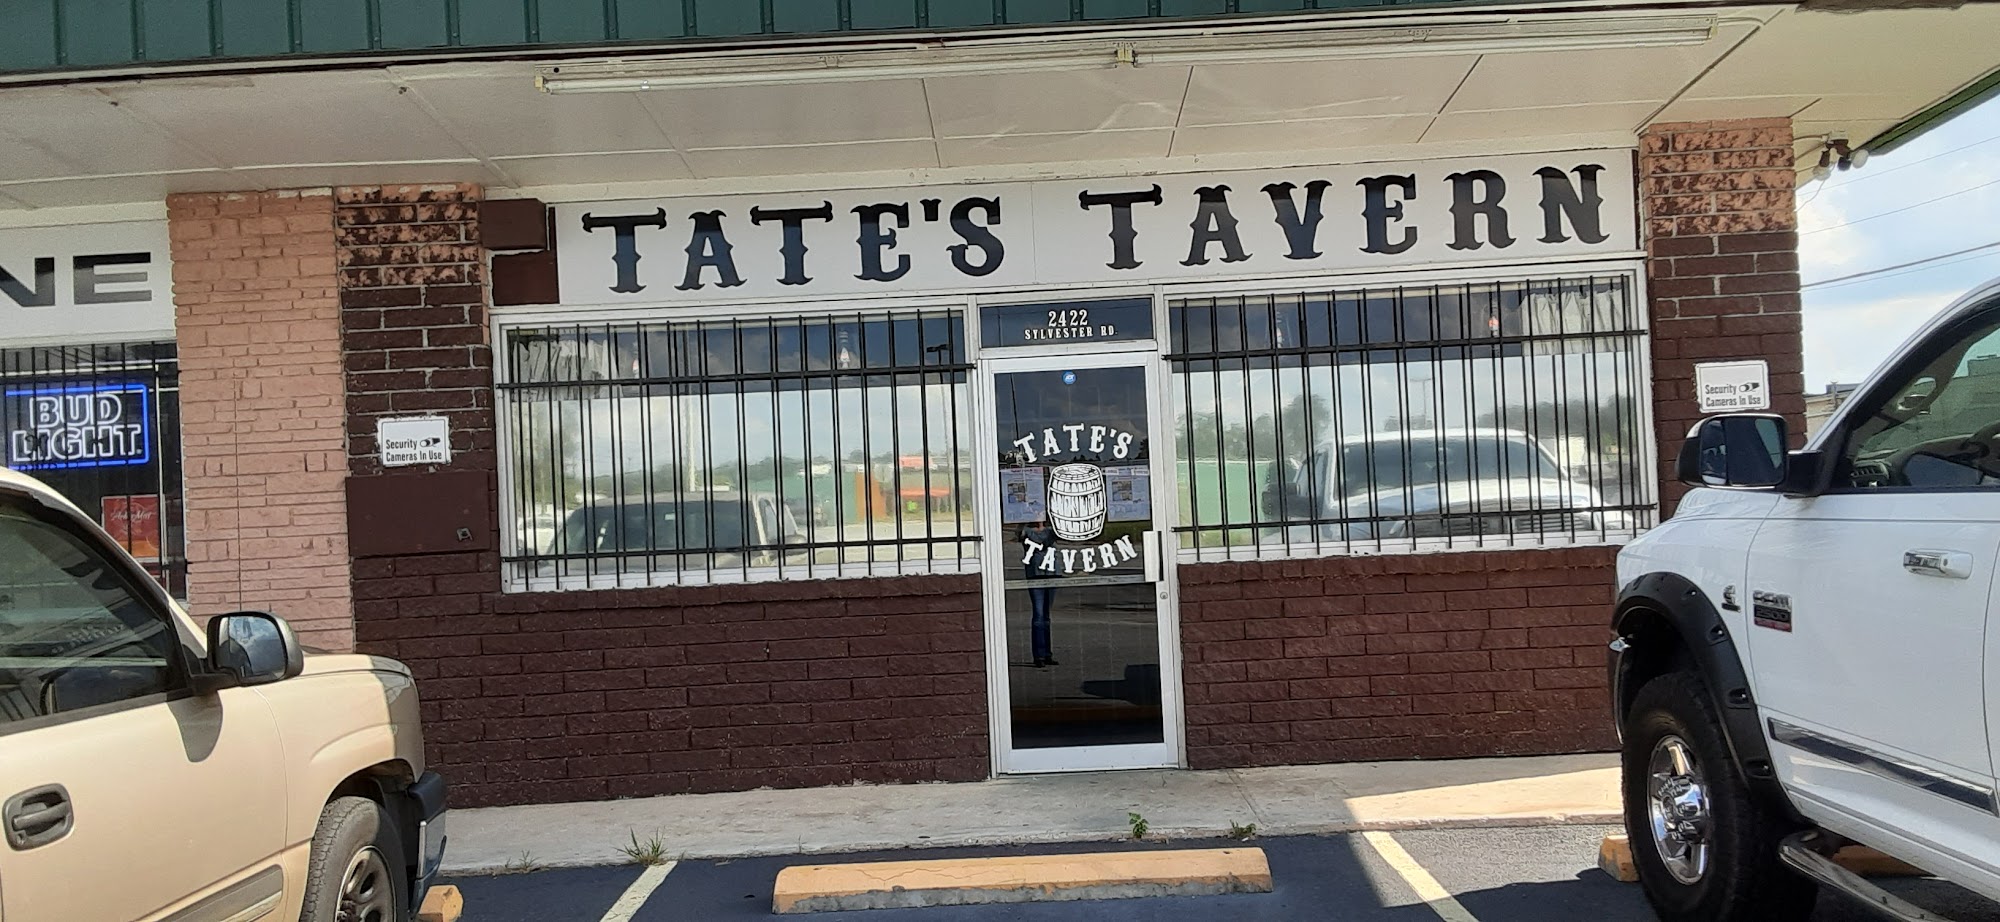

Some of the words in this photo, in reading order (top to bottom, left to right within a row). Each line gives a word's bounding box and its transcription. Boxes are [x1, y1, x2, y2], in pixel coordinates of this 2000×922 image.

[581, 196, 1004, 294] TATE'S
[1078, 163, 1610, 270] TAVERN
[1048, 309, 1088, 327] 2422
[1024, 326, 1094, 340] SYLVESTER
[1705, 384, 1737, 395] Security
[1706, 396, 1737, 407] Cameras
[1739, 395, 1747, 406] In
[1748, 395, 1761, 405] Use
[29, 393, 123, 429] BUD
[12, 423, 142, 462] LIGHT
[386, 439, 417, 450] Security
[1013, 423, 1133, 463] TATE'S
[386, 452, 418, 462] Cameras
[420, 450, 427, 460] In
[429, 450, 442, 460] Use
[1022, 534, 1138, 574] TAVERN
